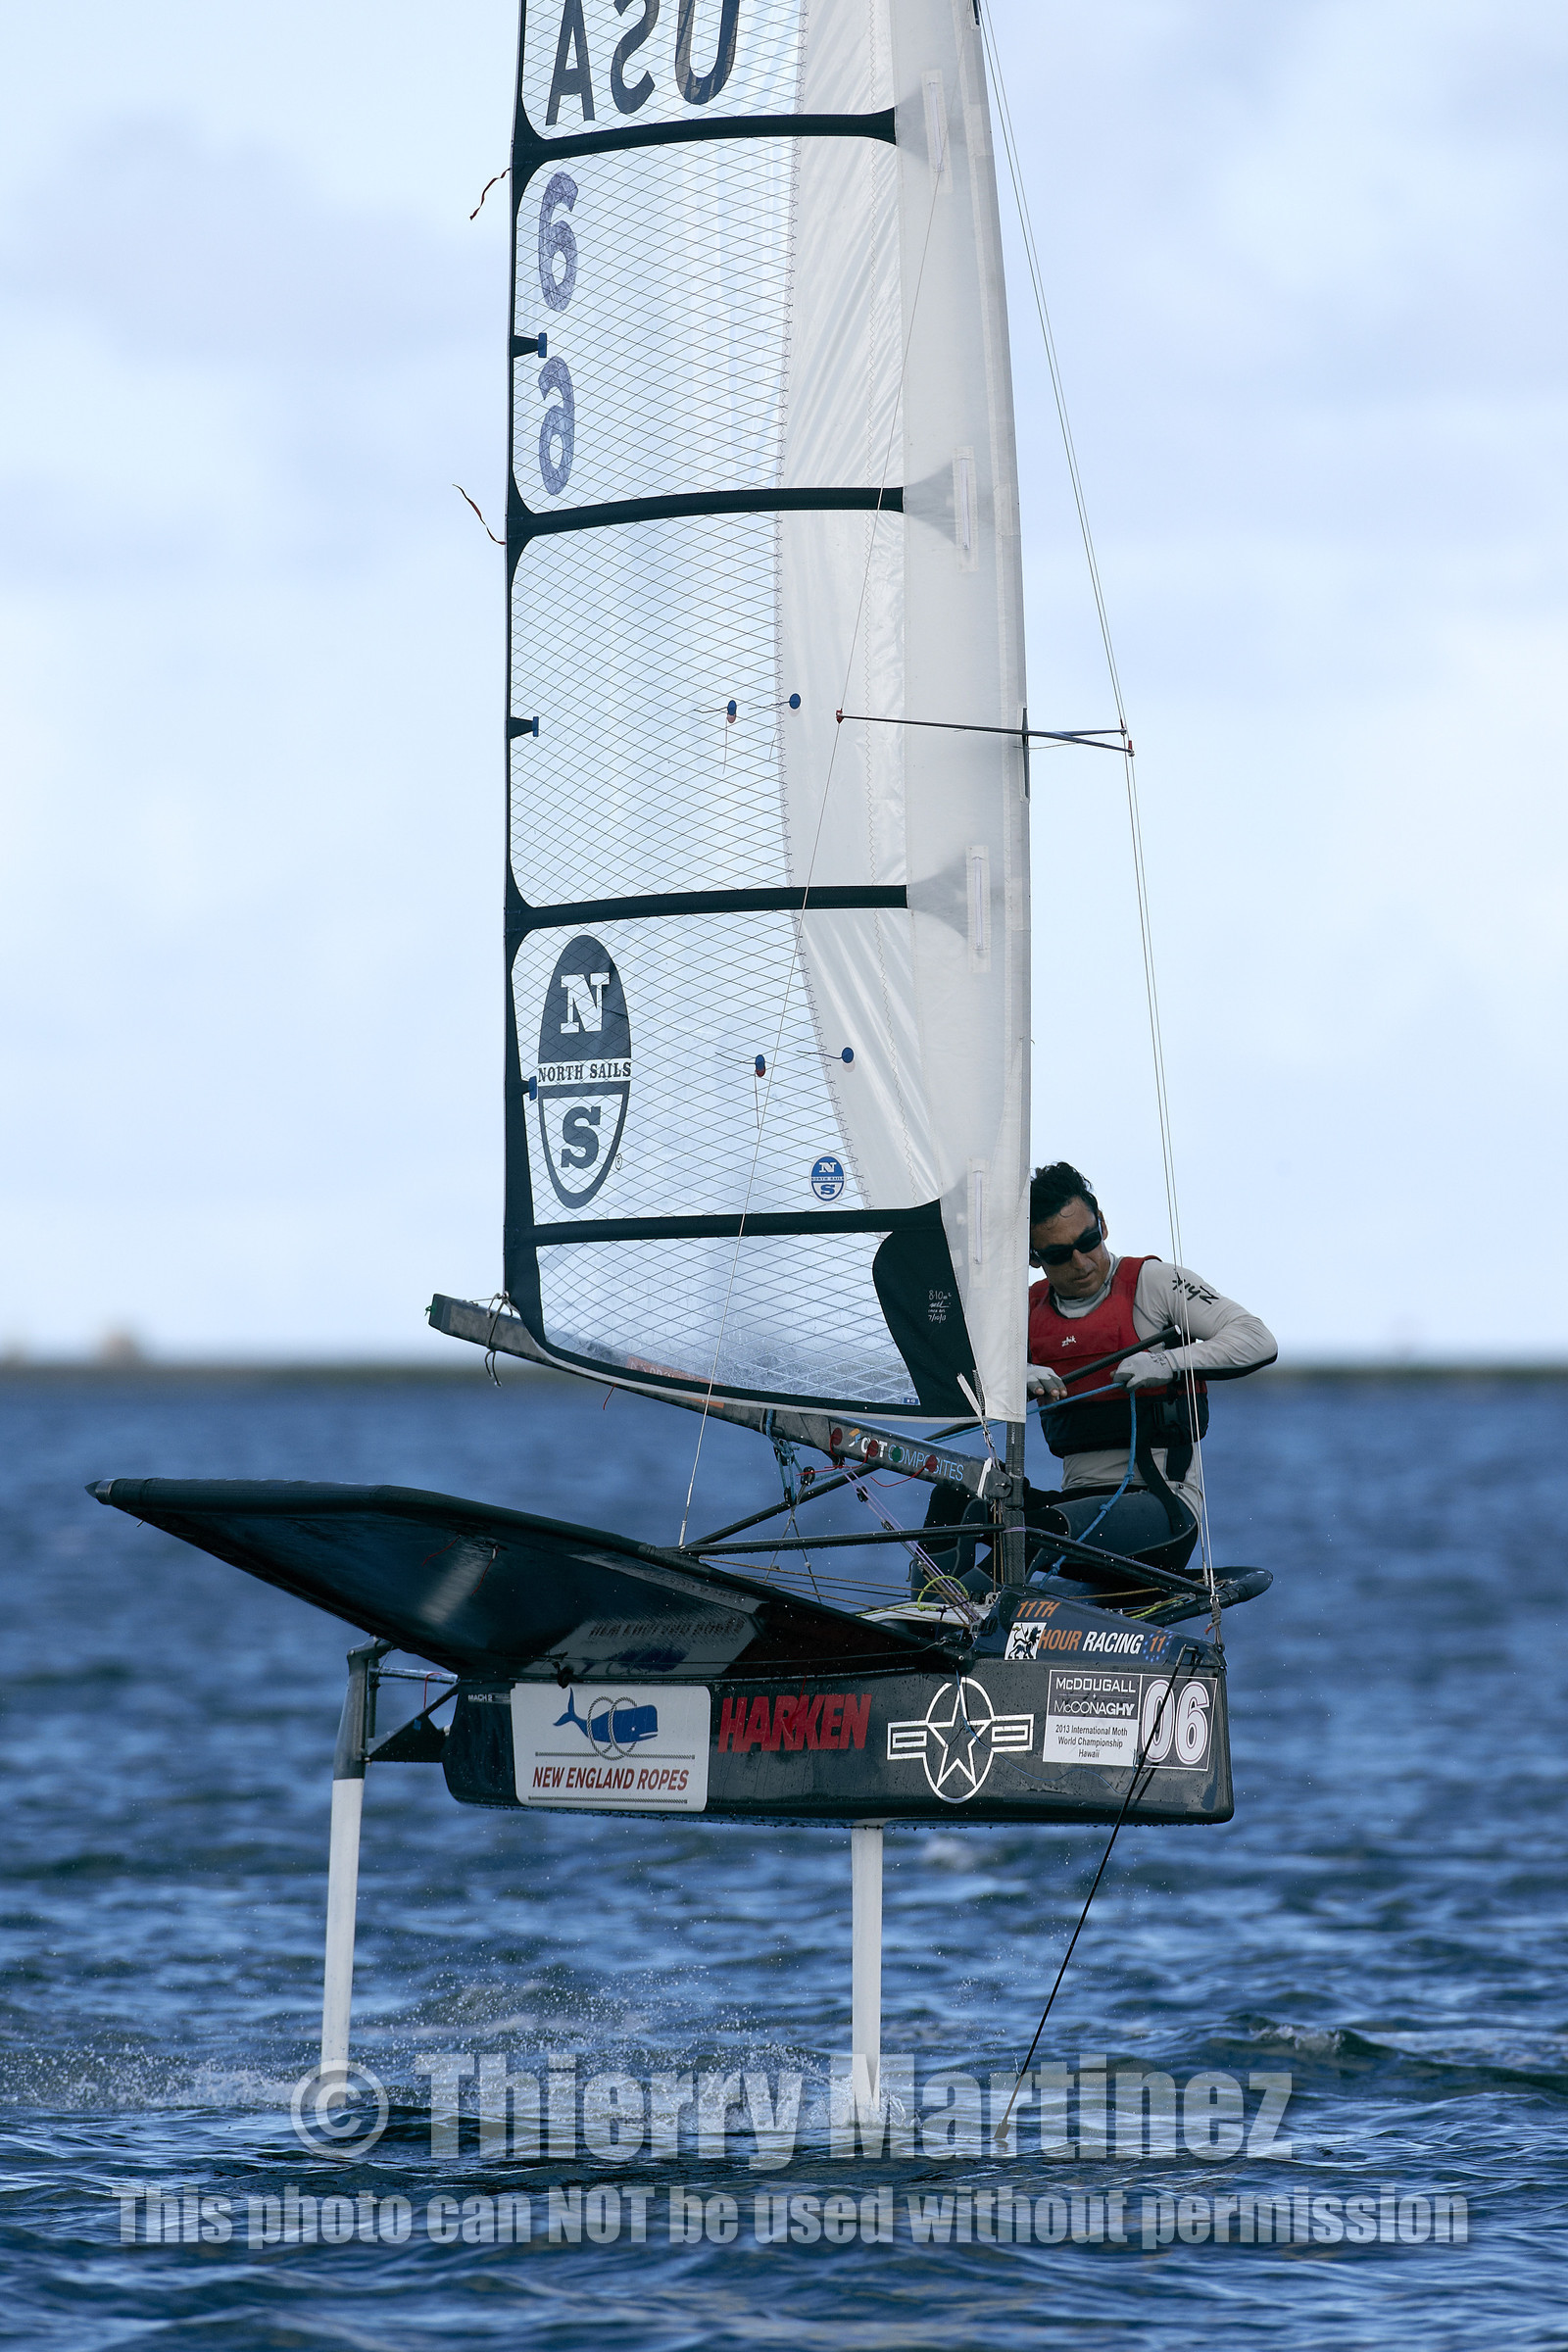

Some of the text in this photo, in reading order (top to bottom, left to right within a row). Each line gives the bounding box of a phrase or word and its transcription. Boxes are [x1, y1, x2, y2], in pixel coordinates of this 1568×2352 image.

[561, 972, 610, 1034] N
[538, 1061, 632, 1083] NORTH SAILS
[561, 1105, 601, 1169] S
[818, 1162, 837, 1173] N
[820, 1184, 835, 1196] S
[1016, 1600, 1061, 1618] 11TH
[1037, 1629, 1145, 1654] HOUR RACING
[717, 1693, 872, 1753] HARKEN
[1055, 1724, 1127, 1737] 2013 International Moth
[1142, 1679, 1210, 1765] 06
[1057, 1736, 1123, 1748] World Championship
[1078, 1748, 1100, 1758] Hawaii
[532, 1766, 690, 1790] NEW ENGLAND ROPES
